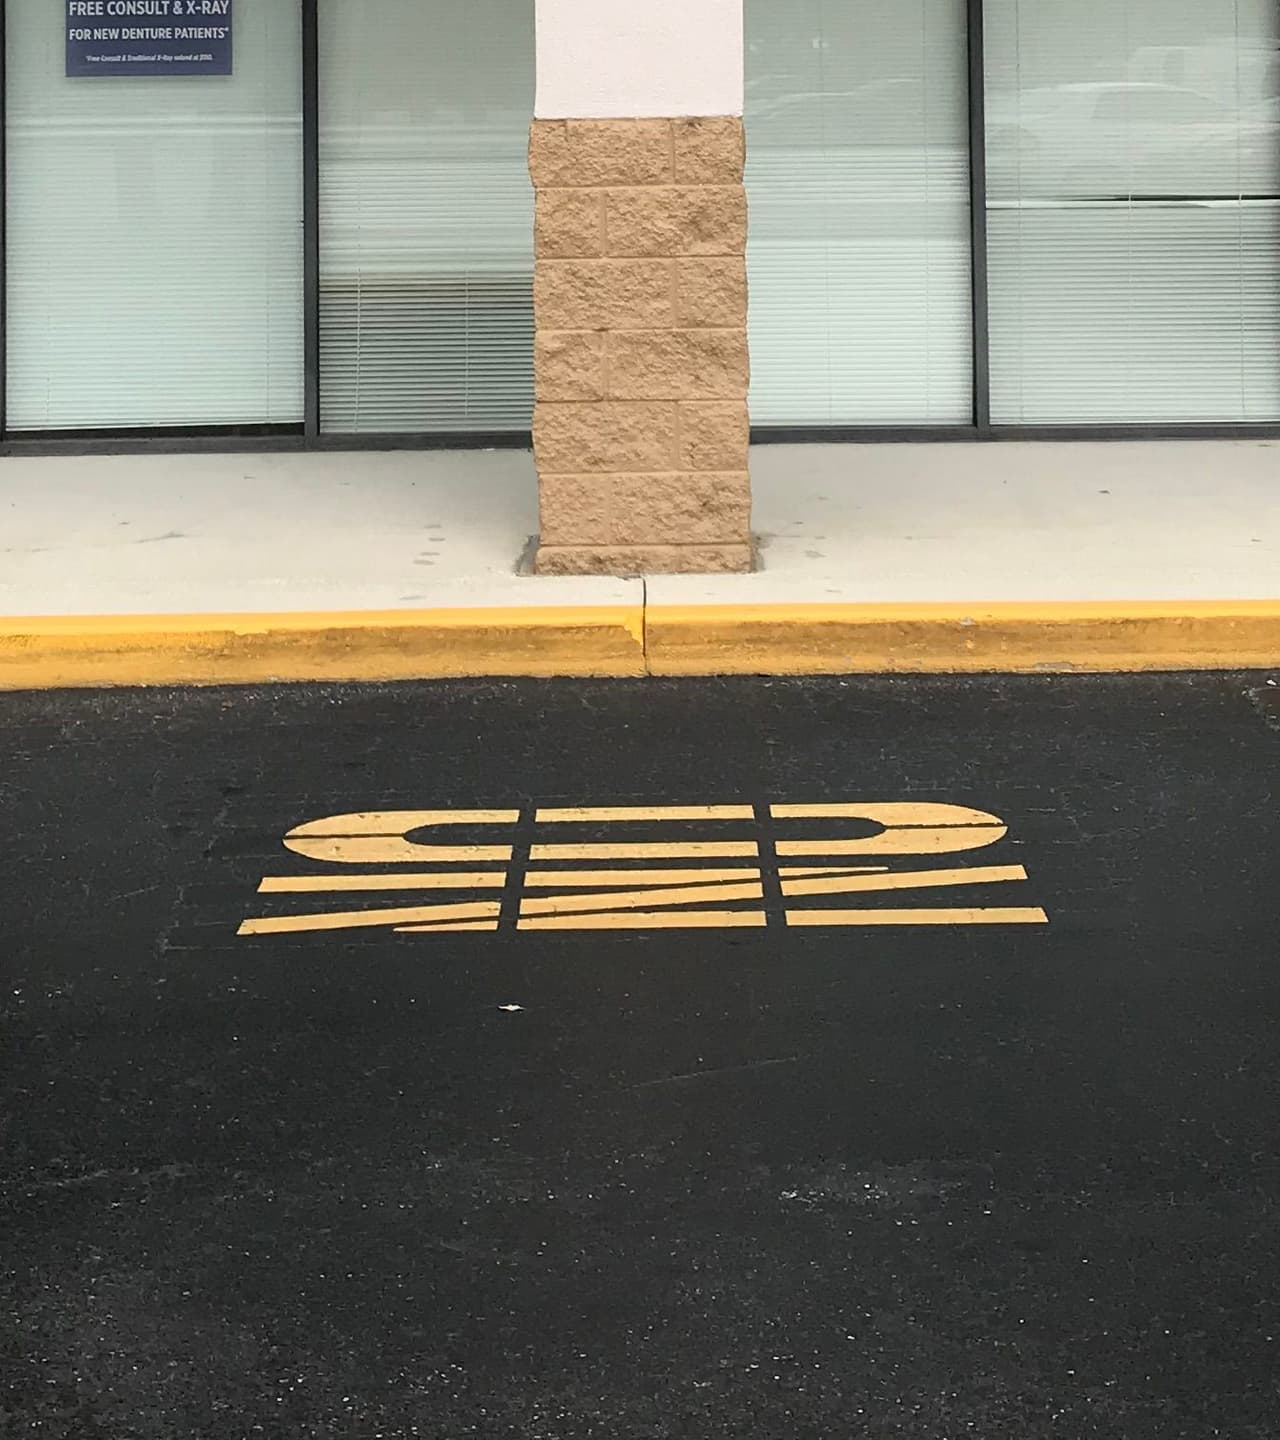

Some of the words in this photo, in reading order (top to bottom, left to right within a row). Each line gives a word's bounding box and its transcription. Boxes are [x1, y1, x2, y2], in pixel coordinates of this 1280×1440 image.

[70, 1, 103, 16] FREE
[107, 0, 170, 15] CONSULT
[173, 0, 183, 14] &
[186, 0, 229, 14] X-RAY
[70, 28, 91, 40] FOR
[93, 28, 119, 40] NEW
[122, 27, 172, 39] DENTURE
